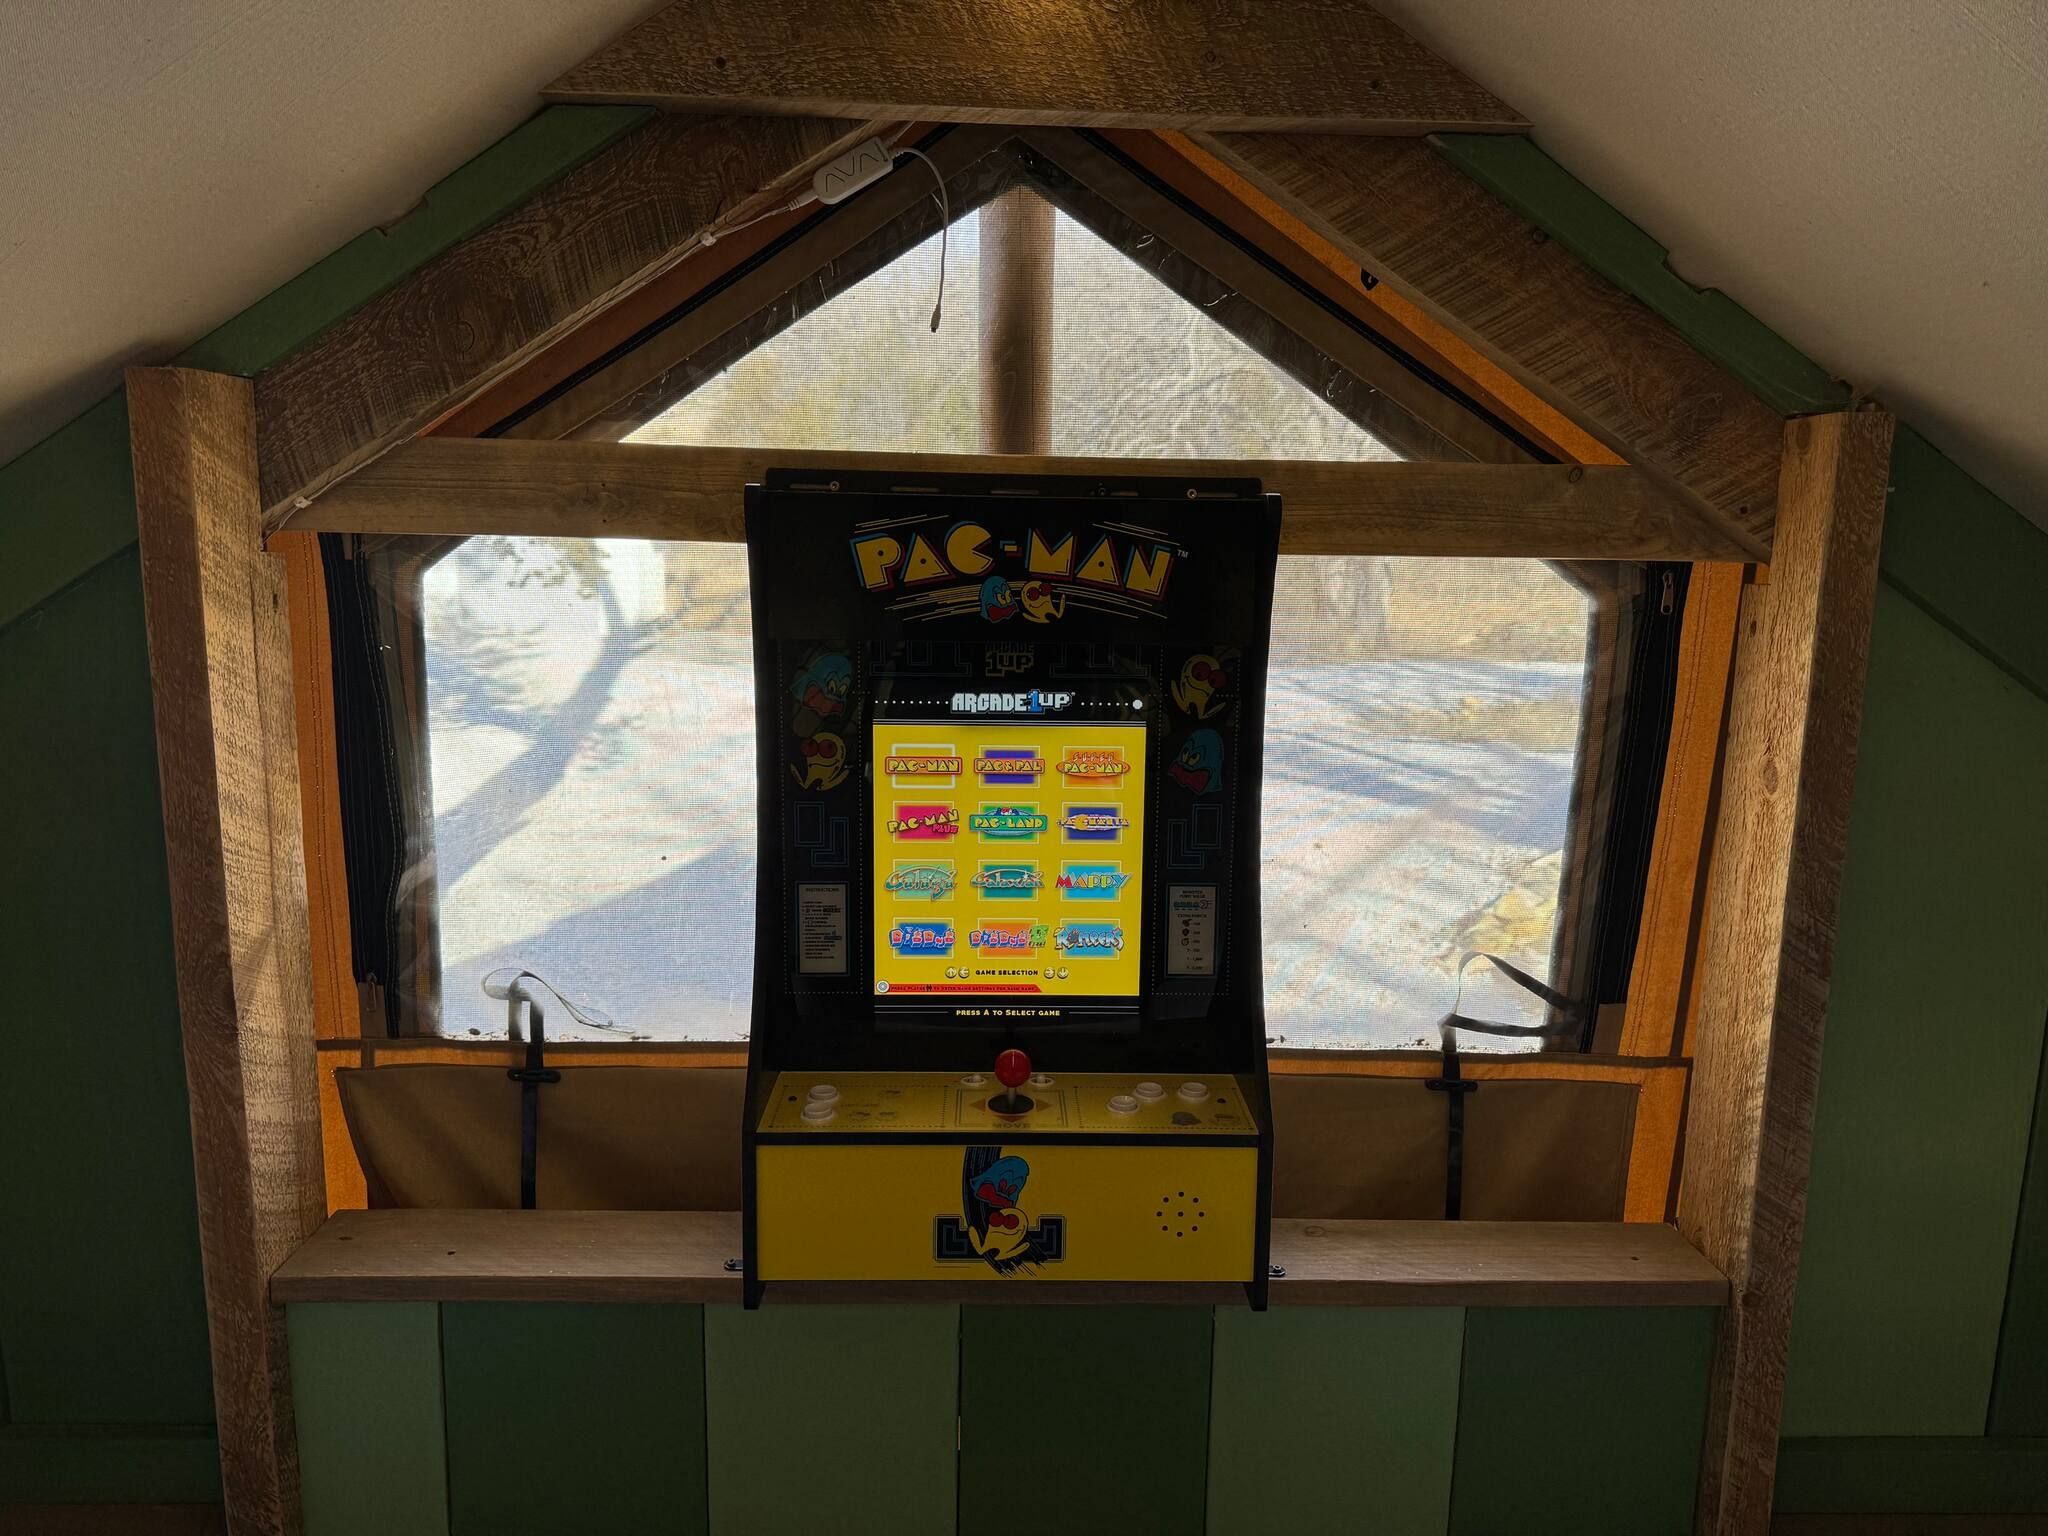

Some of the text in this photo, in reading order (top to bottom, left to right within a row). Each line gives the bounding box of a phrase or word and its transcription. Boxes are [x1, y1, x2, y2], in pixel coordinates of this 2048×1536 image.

[850, 522, 1174, 599] PAC-MAN
[887, 759, 960, 773] PAC-MAN
[976, 760, 1002, 772] PAC
[1015, 760, 1042, 772] PAL
[1063, 761, 1123, 773] PAC-MAN
[887, 809, 959, 833] PAC-MAN
[975, 818, 1043, 828] PAC-LAND
